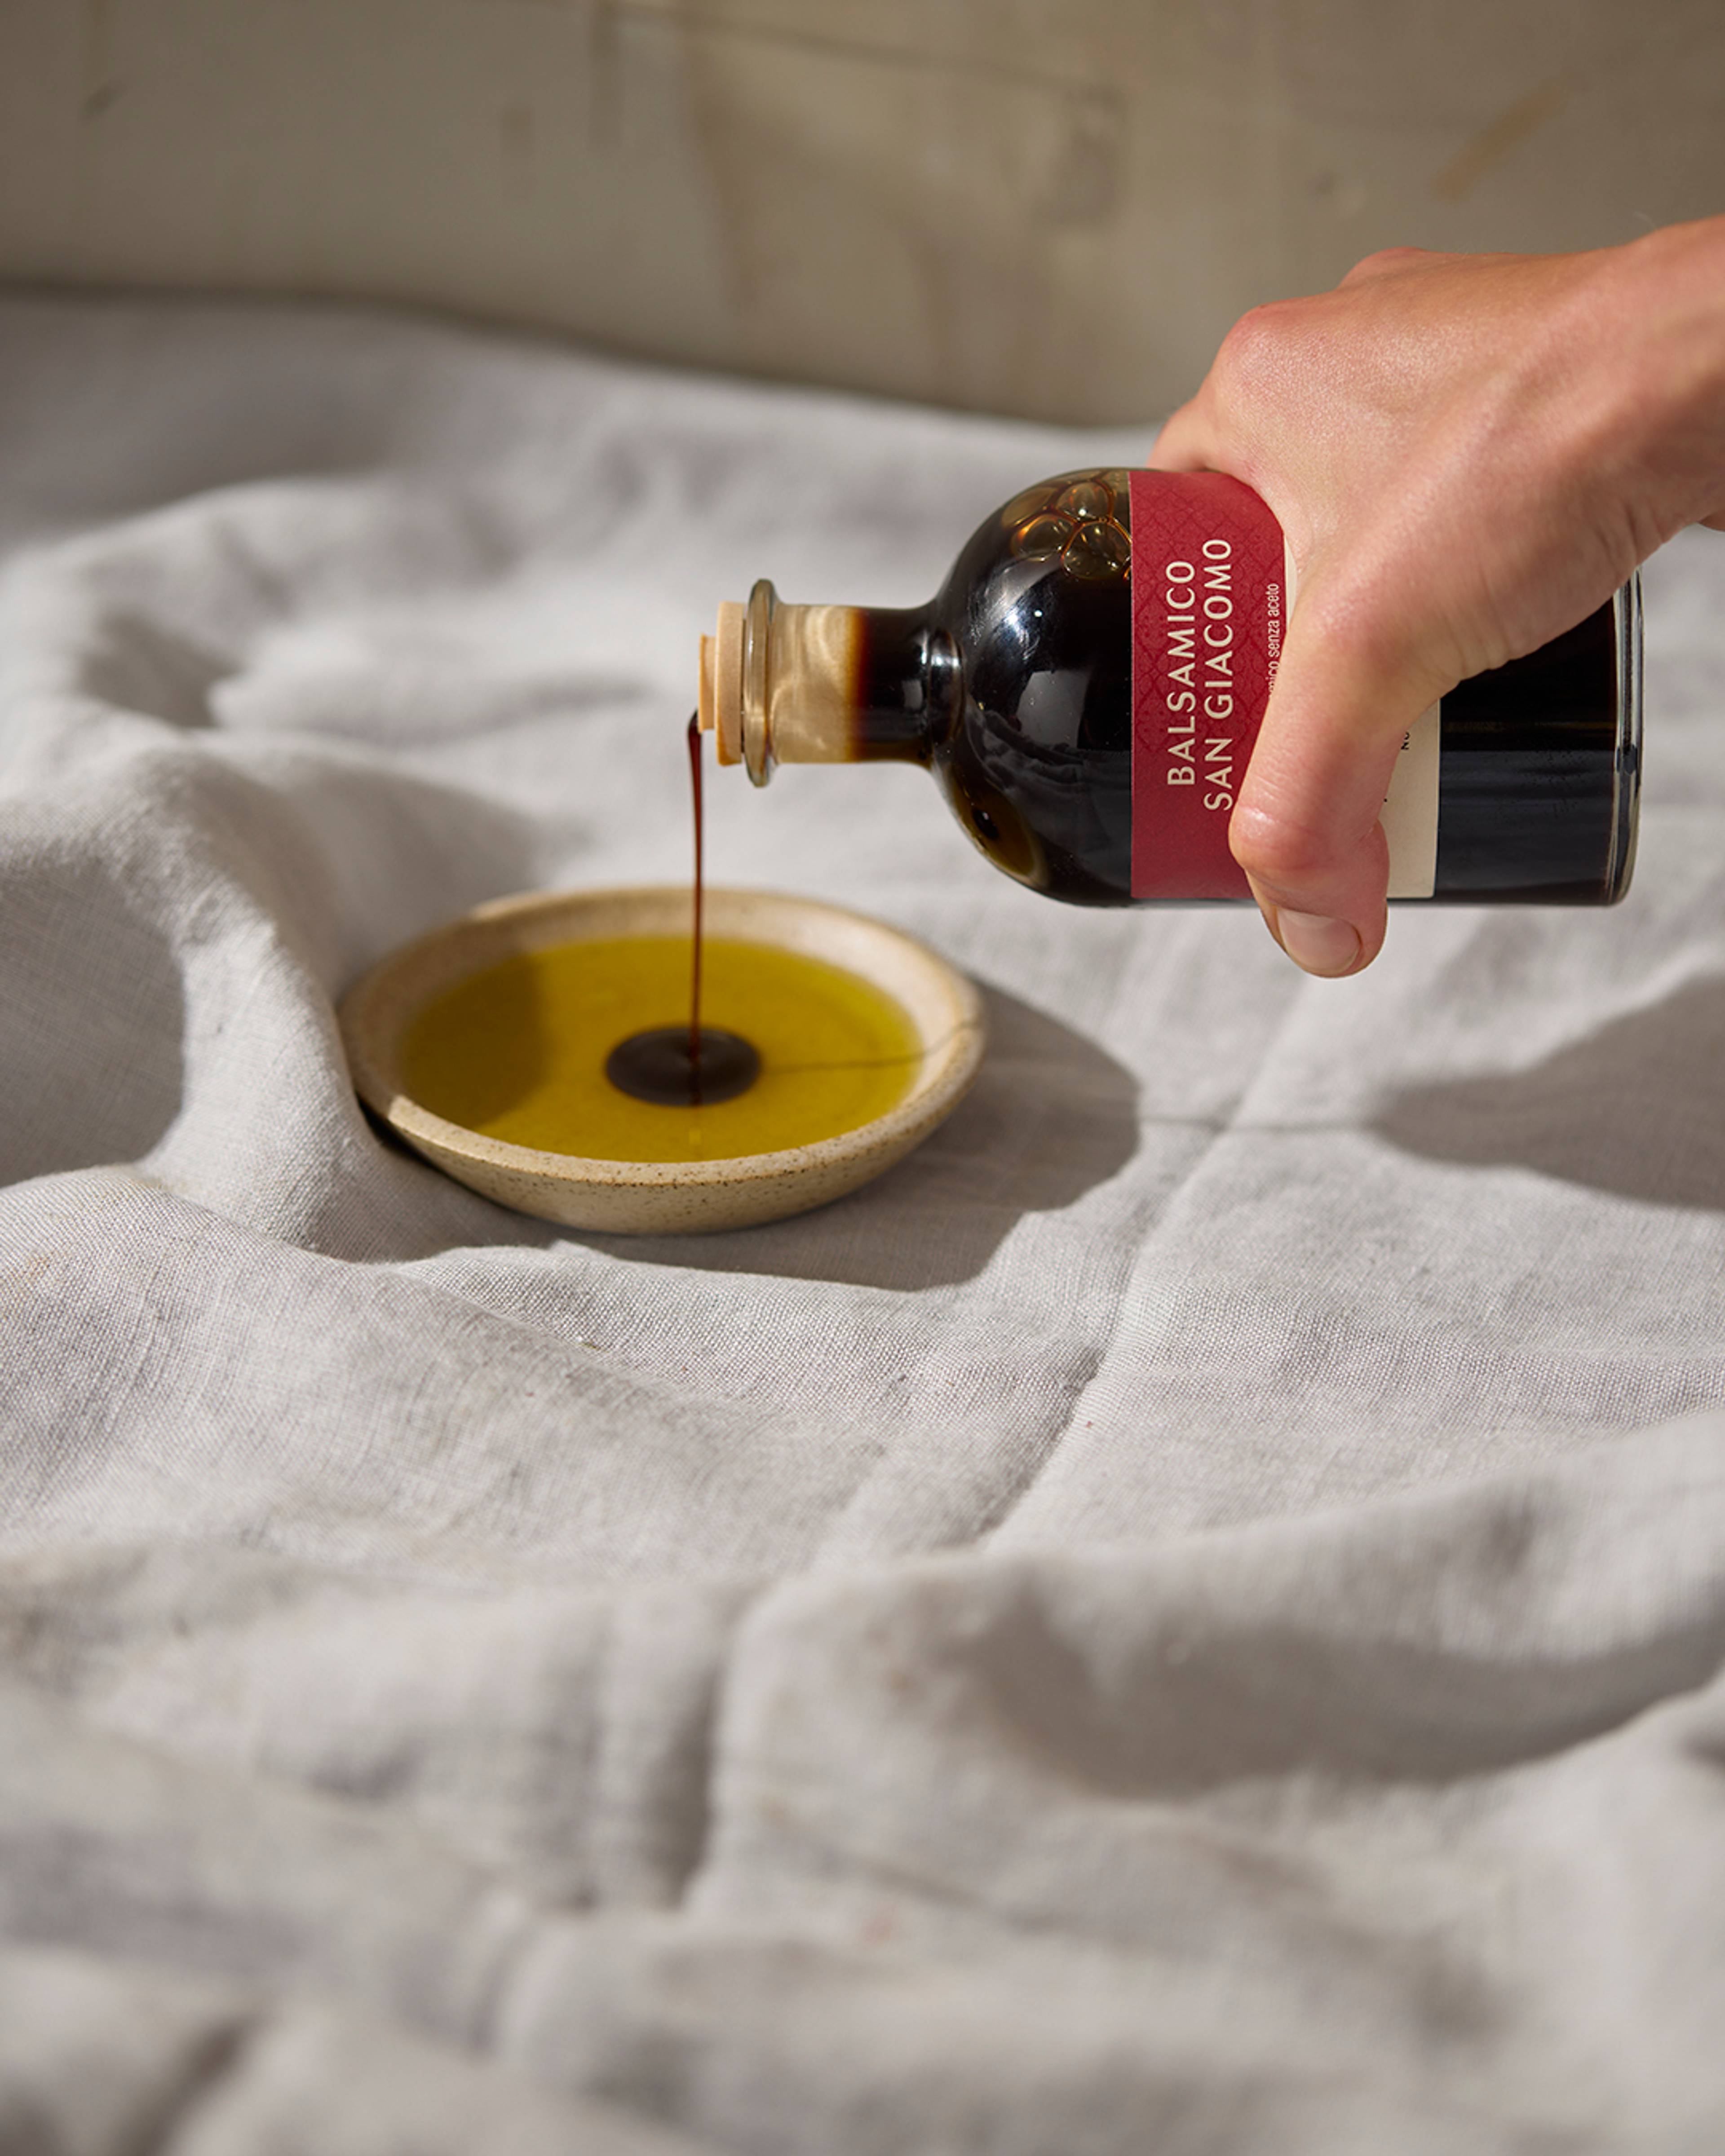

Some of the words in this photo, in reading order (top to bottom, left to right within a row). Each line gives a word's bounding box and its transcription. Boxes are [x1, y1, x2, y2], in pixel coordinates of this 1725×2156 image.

[1203, 539, 1233, 719] GIACOMO
[1265, 583, 1280, 617] aceto
[1166, 561, 1195, 785] BALSAMICO
[1268, 620, 1280, 658] senza
[1203, 739, 1233, 810] SAN
